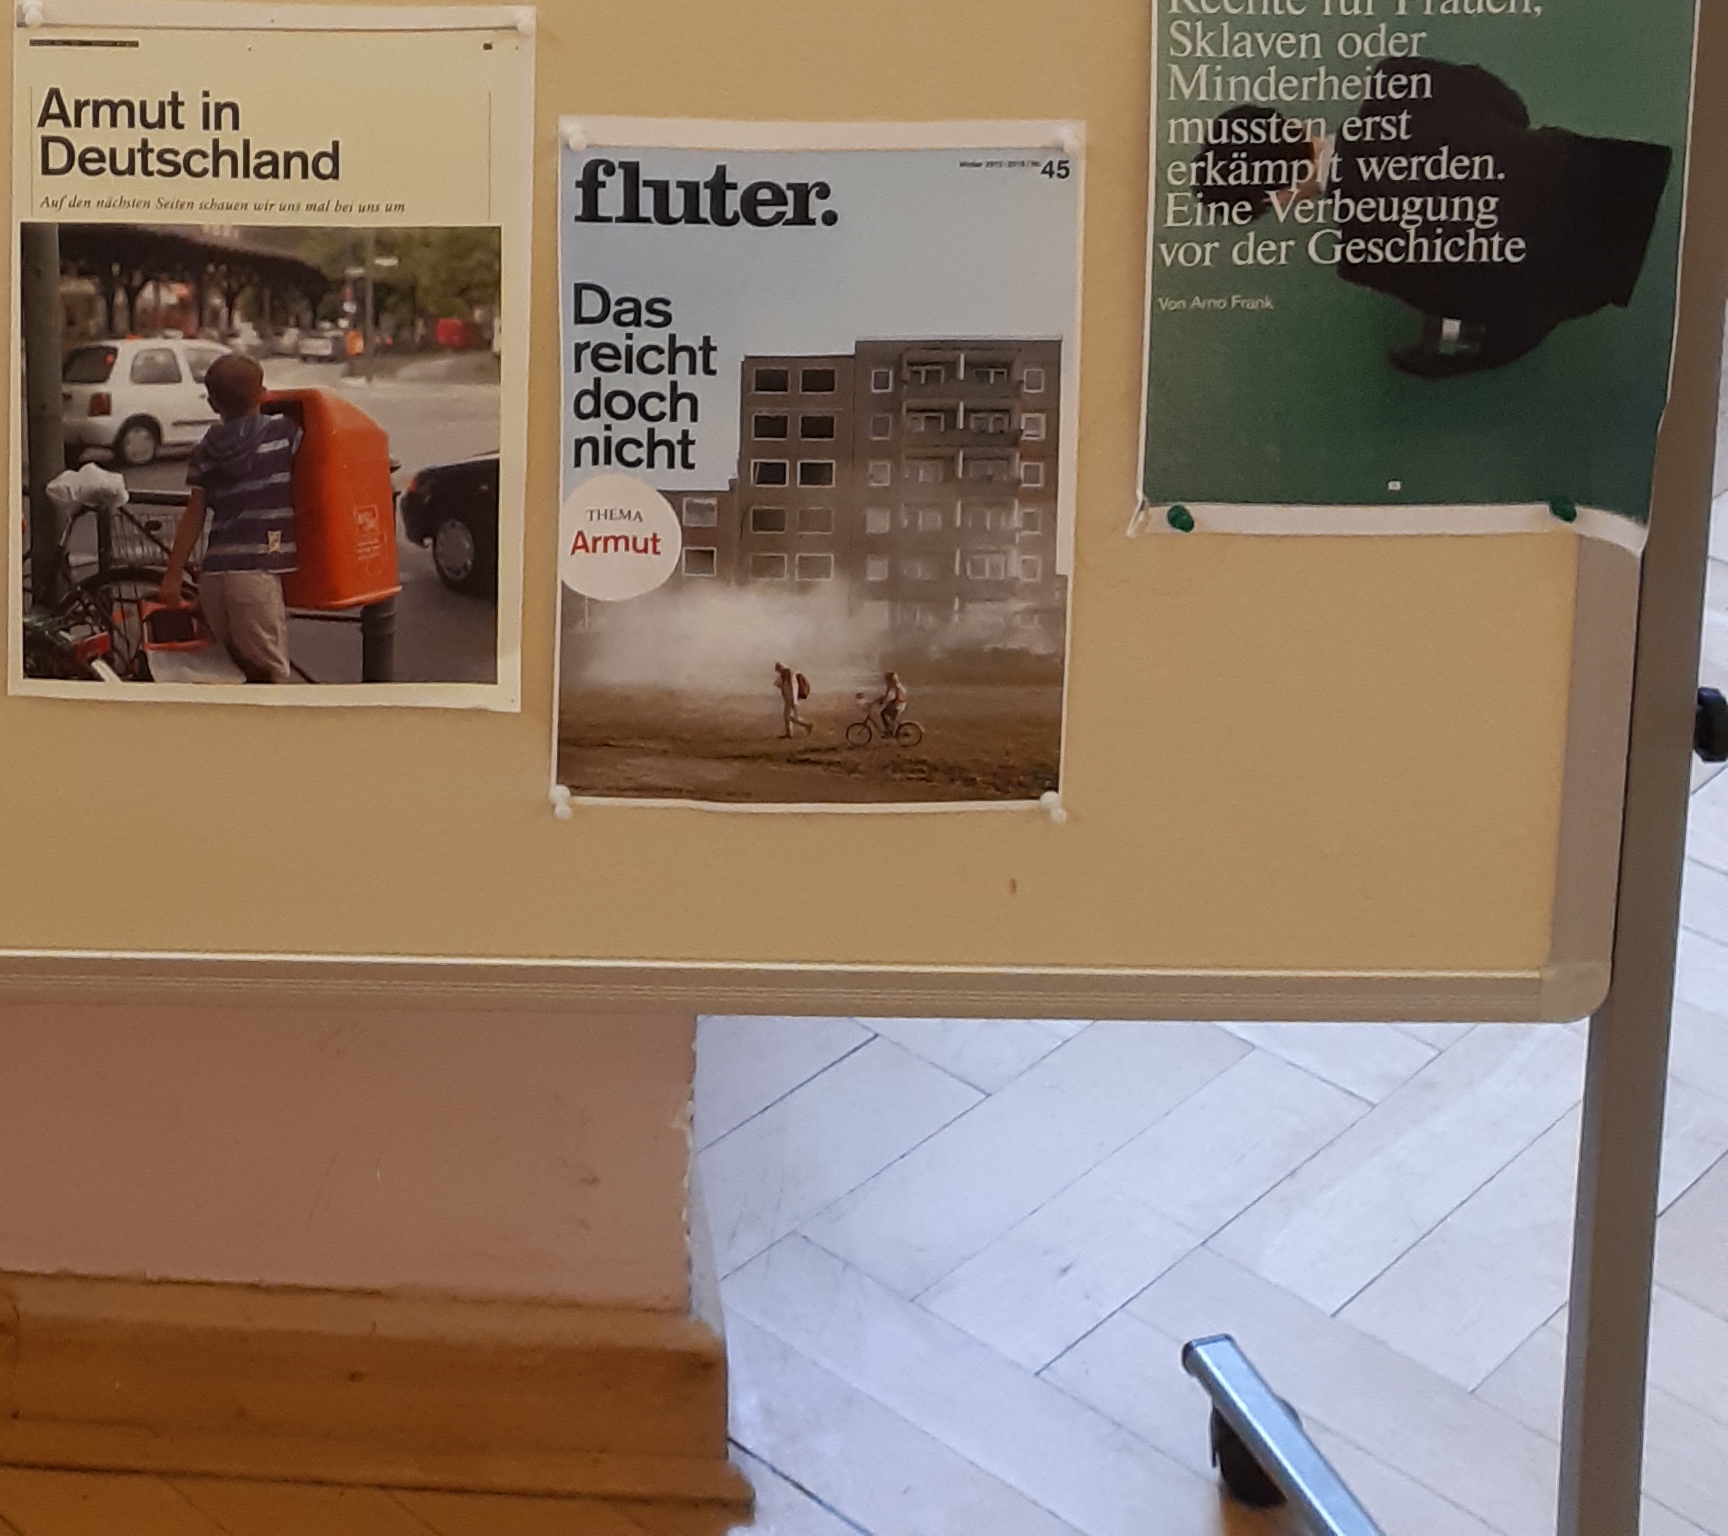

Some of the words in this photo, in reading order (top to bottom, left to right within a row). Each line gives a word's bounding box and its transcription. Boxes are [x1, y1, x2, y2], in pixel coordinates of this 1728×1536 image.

[1170, 21, 1322, 58] Sklaven
[1338, 24, 1427, 58] oder
[1168, 65, 1433, 102] Minderheiten
[37, 87, 185, 130] Armut
[201, 90, 240, 131] in
[1168, 111, 1326, 145] mussten
[1341, 111, 1412, 140] erst
[40, 135, 340, 181] Deutschland
[1040, 160, 1070, 180] 45
[1167, 150, 1343, 195] erkämpft
[1358, 147, 1506, 181] werden.
[41, 196, 67, 211] Auf
[69, 196, 91, 208] den
[156, 198, 194, 210] Seiten
[199, 199, 248, 211] schauen
[575, 159, 839, 227] fluter.
[1165, 193, 1253, 226] Eine
[1269, 189, 1499, 231] Verbeugung
[1159, 239, 1219, 266] vor
[1232, 234, 1295, 265] der
[1308, 229, 1527, 264] Geschichte
[573, 283, 672, 328] Das
[1159, 297, 1186, 309] Von
[1191, 296, 1226, 308] Arno
[1231, 294, 1274, 309] Frank
[574, 333, 717, 376] reicht
[574, 378, 698, 424] doch
[574, 425, 696, 470] nicht
[587, 508, 643, 523] THEMA
[570, 530, 661, 557] Armut
